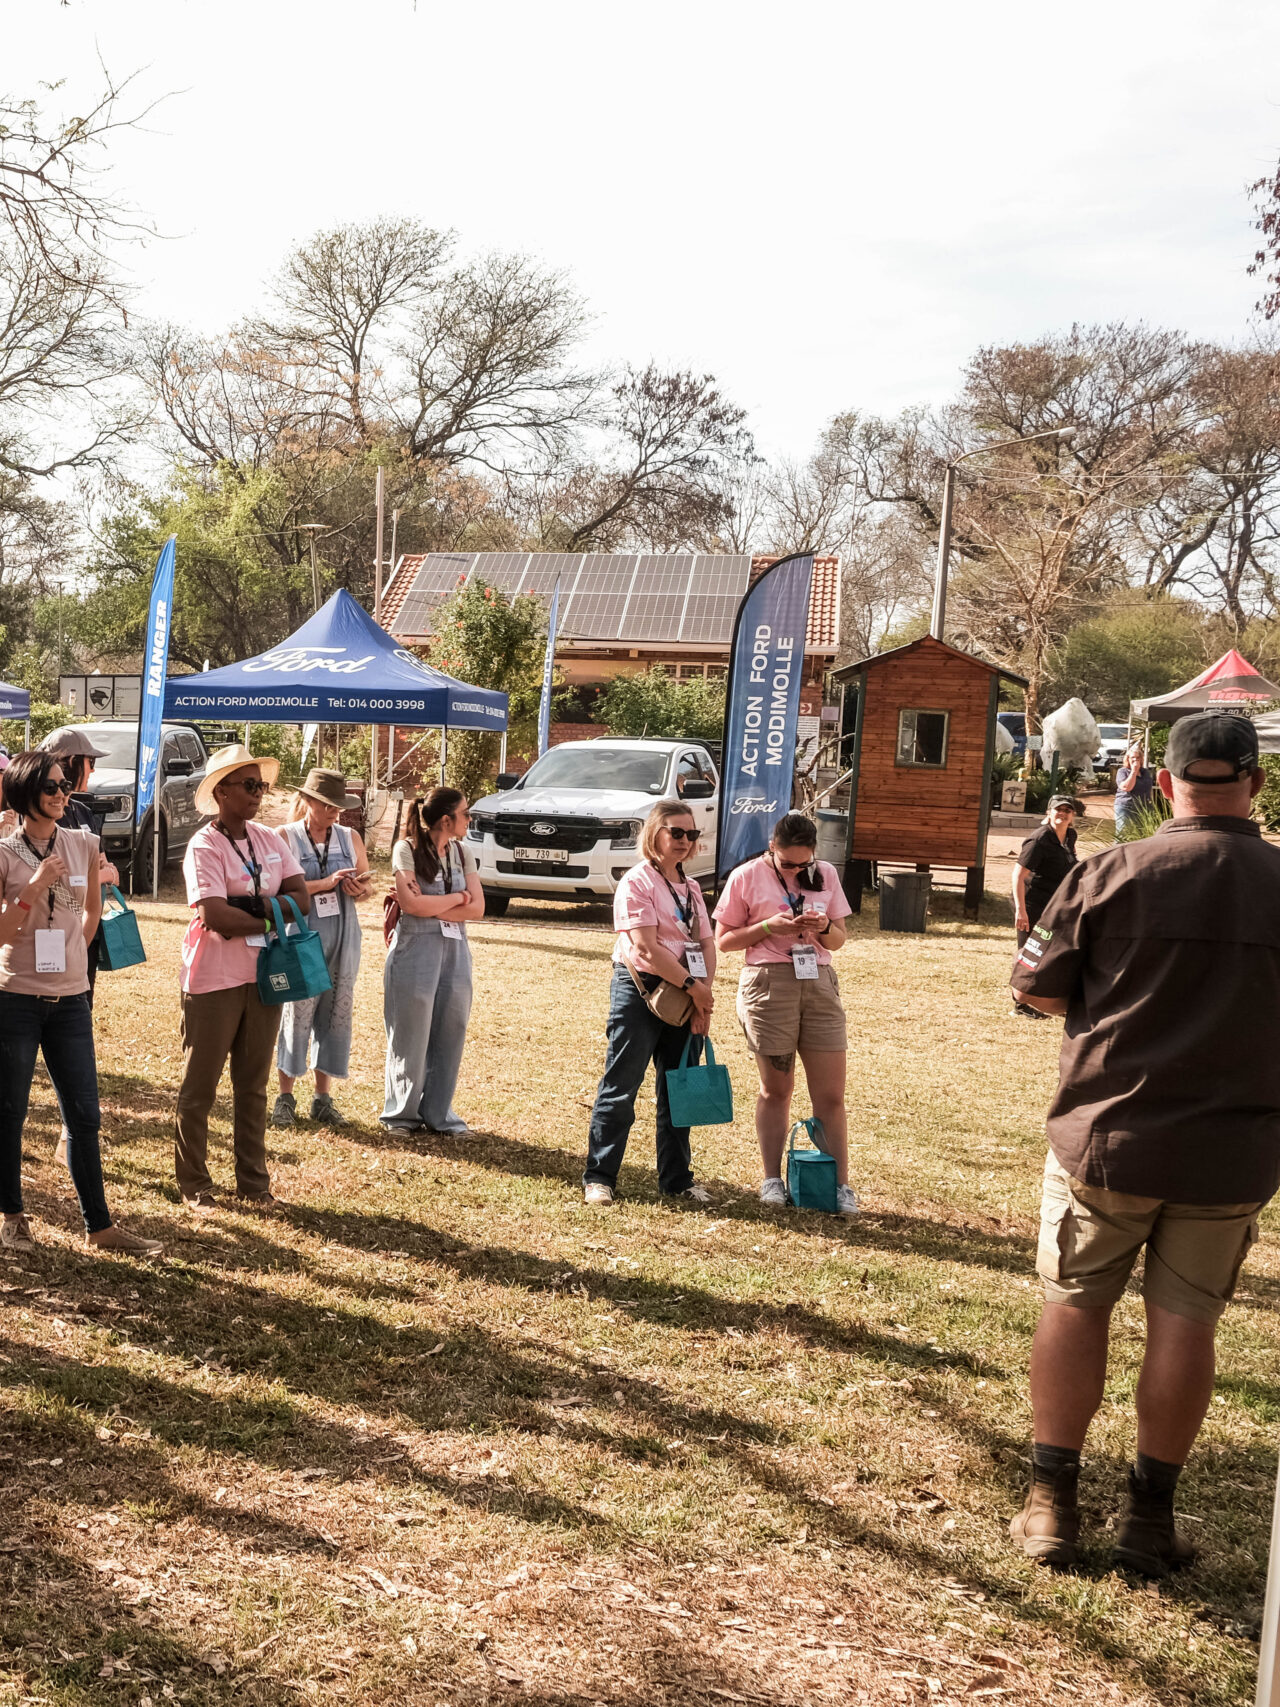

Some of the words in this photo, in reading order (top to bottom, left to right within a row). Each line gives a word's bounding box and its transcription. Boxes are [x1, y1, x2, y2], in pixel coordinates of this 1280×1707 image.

[147, 600, 167, 697] RANGER
[750, 624, 771, 683] FORD
[242, 647, 376, 674] Ford
[174, 696, 216, 706] ACTION
[217, 696, 247, 707] FORD
[249, 696, 318, 708] MODIMOLLE
[327, 697, 347, 709] Tel:
[348, 698, 368, 709] 014
[370, 699, 393, 709] 000
[395, 700, 425, 710] 3998
[765, 637, 794, 766] MODIMOLLE
[740, 696, 764, 777] ACTION
[730, 796, 778, 815] Ford
[515, 849, 530, 858] HPL
[535, 849, 550, 859] 739
[561, 851, 566, 860] L
[318, 897, 327, 905] 20
[797, 957, 806, 966] 19
